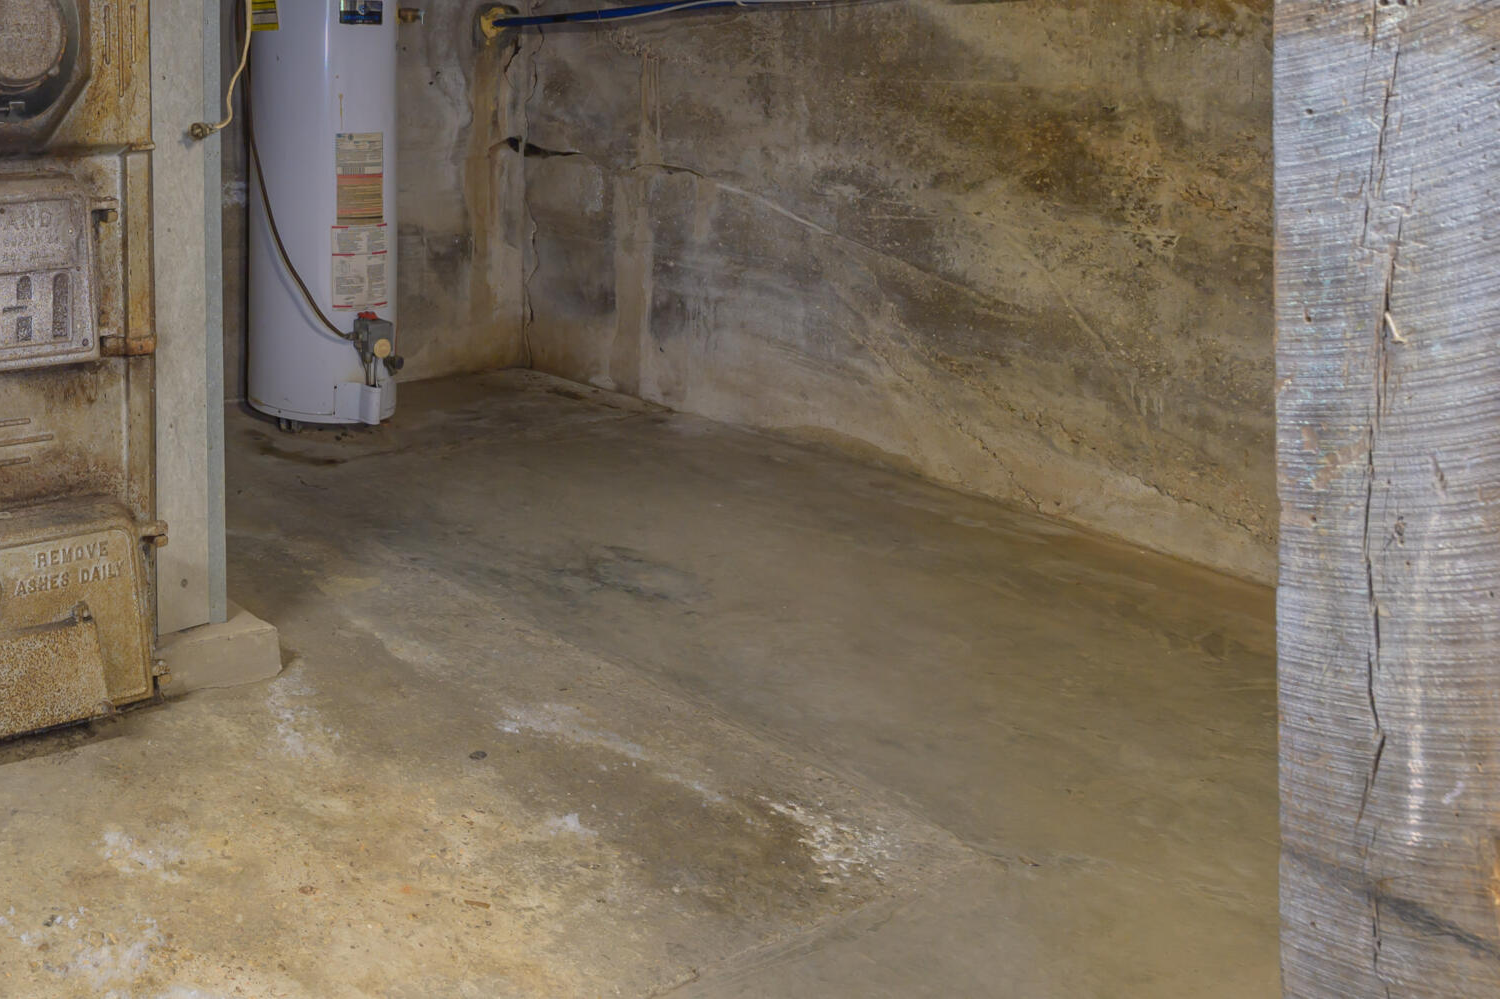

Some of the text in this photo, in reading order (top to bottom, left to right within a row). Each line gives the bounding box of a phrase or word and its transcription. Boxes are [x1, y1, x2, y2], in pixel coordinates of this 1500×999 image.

[35, 540, 109, 568] REMOVE
[14, 560, 125, 597] ASHES DAILY
